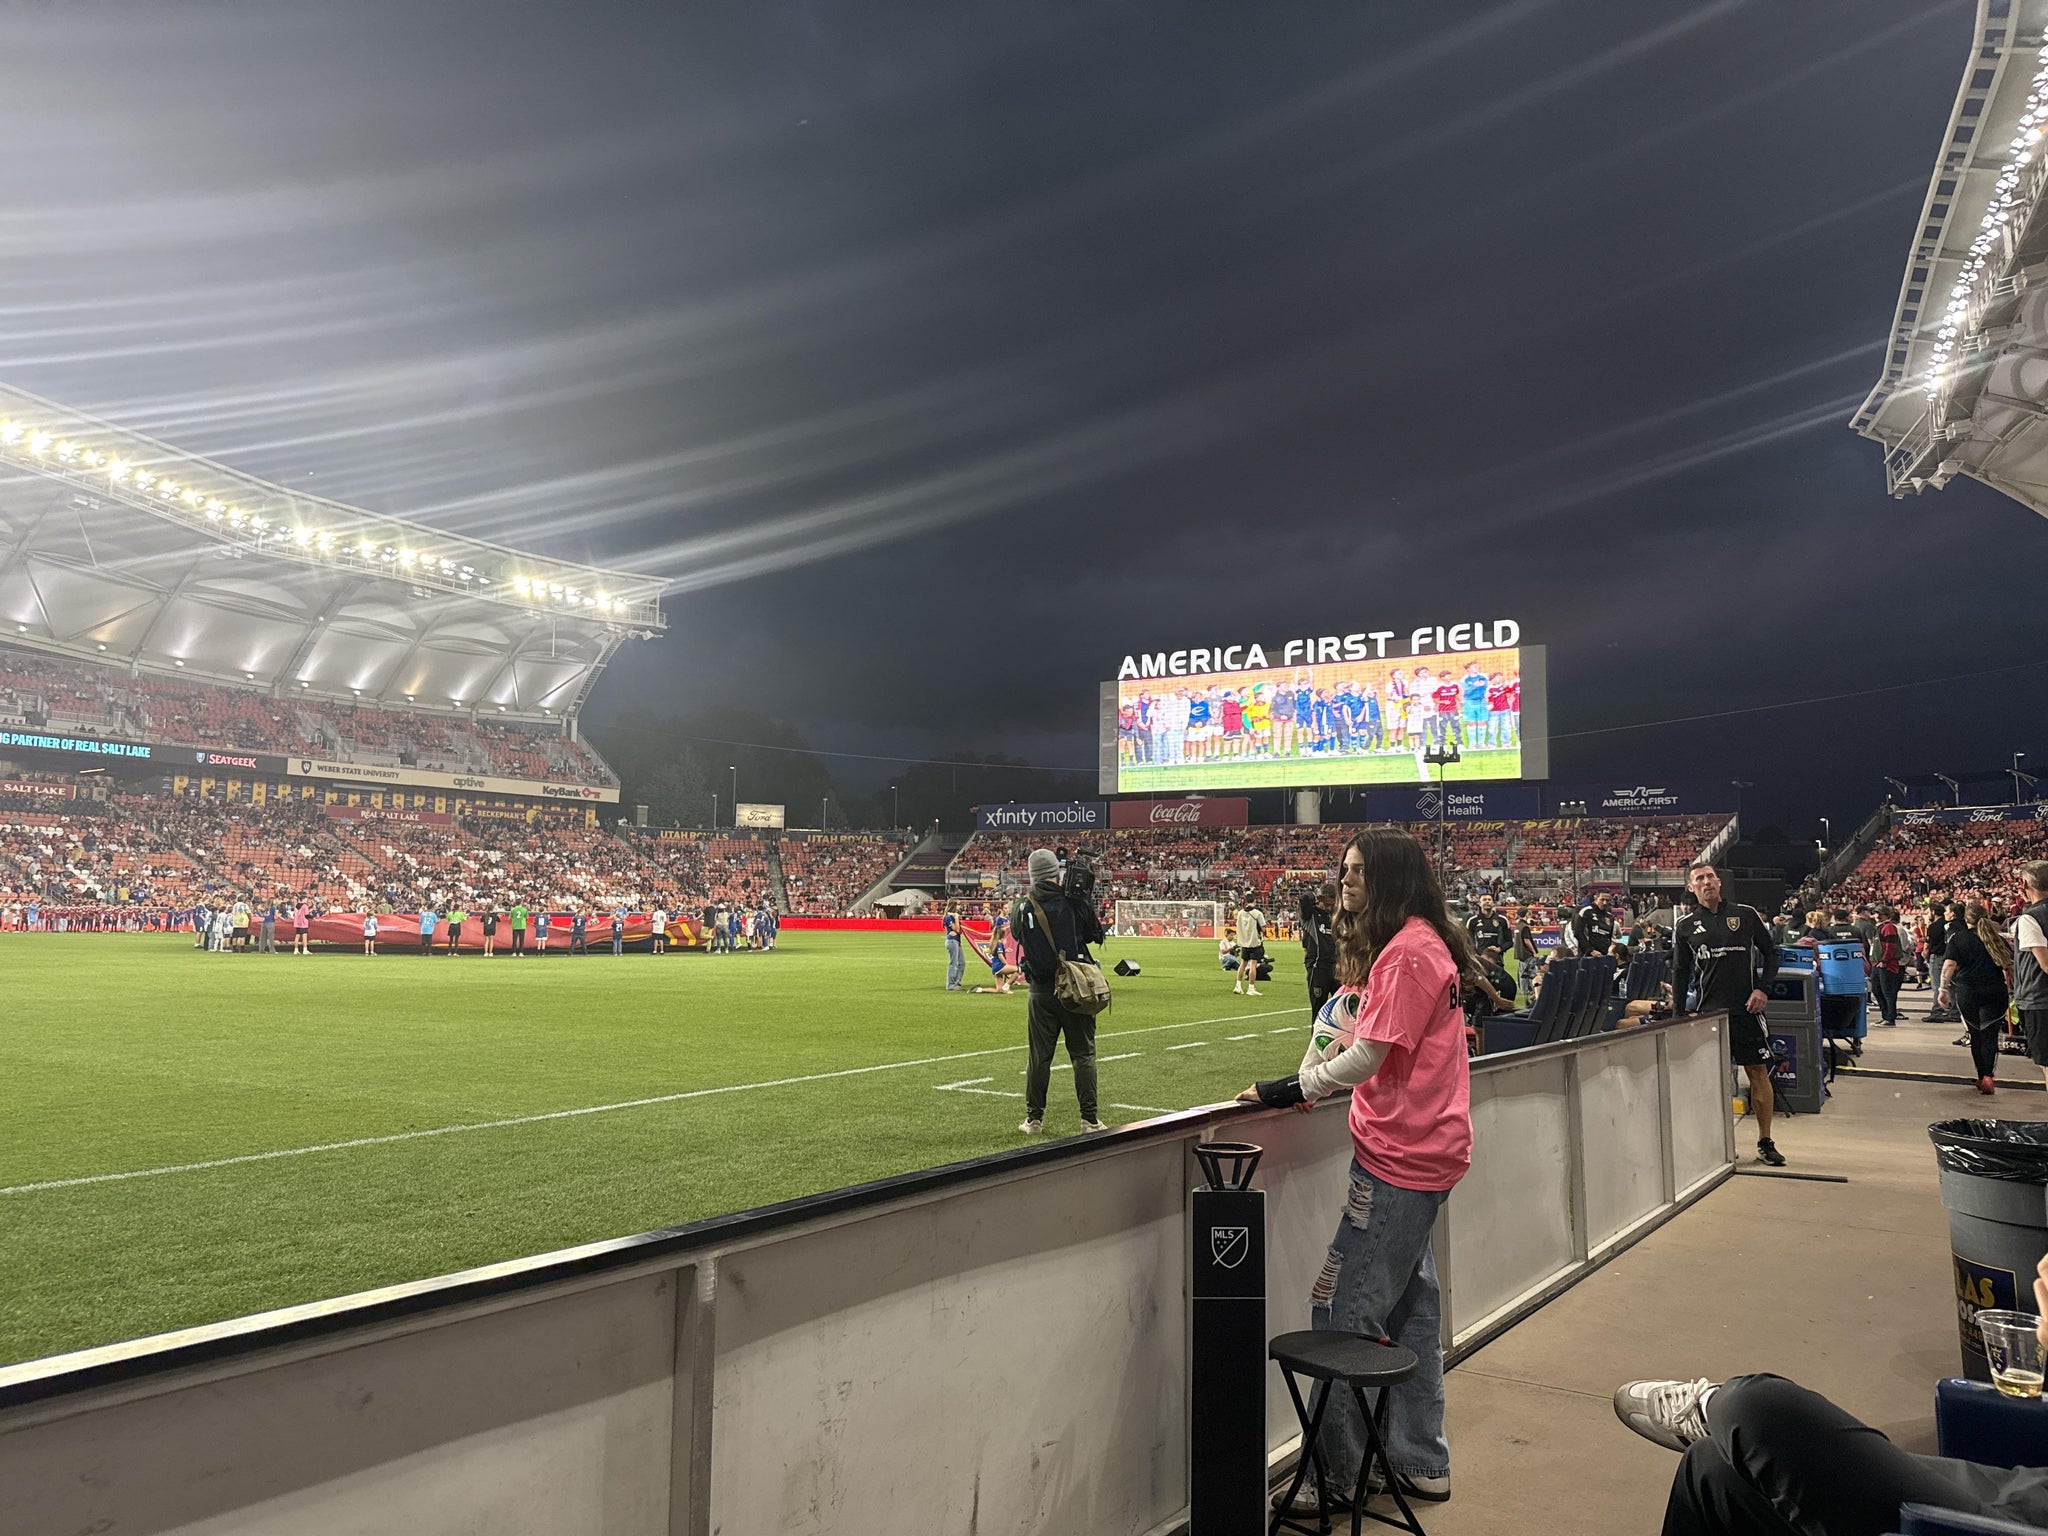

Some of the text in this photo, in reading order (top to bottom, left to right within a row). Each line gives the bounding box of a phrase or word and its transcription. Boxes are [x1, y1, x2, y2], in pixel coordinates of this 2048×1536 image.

[1117, 619, 1520, 681] AMERICA FIRST FIELD
[11, 734, 60, 749] PARTNER
[61, 739, 76, 751] OF
[76, 740, 101, 753] REAL
[101, 742, 127, 756] SALT
[127, 745, 151, 758] LAKE
[209, 754, 257, 769] SEATGEEK
[317, 765, 400, 779] WEBER STATE UNIVERSITY
[4, 783, 67, 796] SALT LAKE
[542, 785, 582, 798] KeyBank
[1447, 793, 1485, 806] Select
[1602, 796, 1679, 807] AMERICA FIRST
[360, 809, 379, 820] REAL
[400, 812, 420, 822] LAKE
[747, 810, 773, 822] Ford
[985, 807, 1096, 827] xfinity mobile
[1150, 803, 1203, 823] Coca-Cola
[1447, 805, 1483, 816] Health
[1969, 808, 2004, 823] Ford
[1902, 812, 1935, 825] Ford
[660, 830, 688, 840] UTAH
[807, 834, 883, 845] UTAH ROYALS
[1214, 1230, 1234, 1239] MLS
